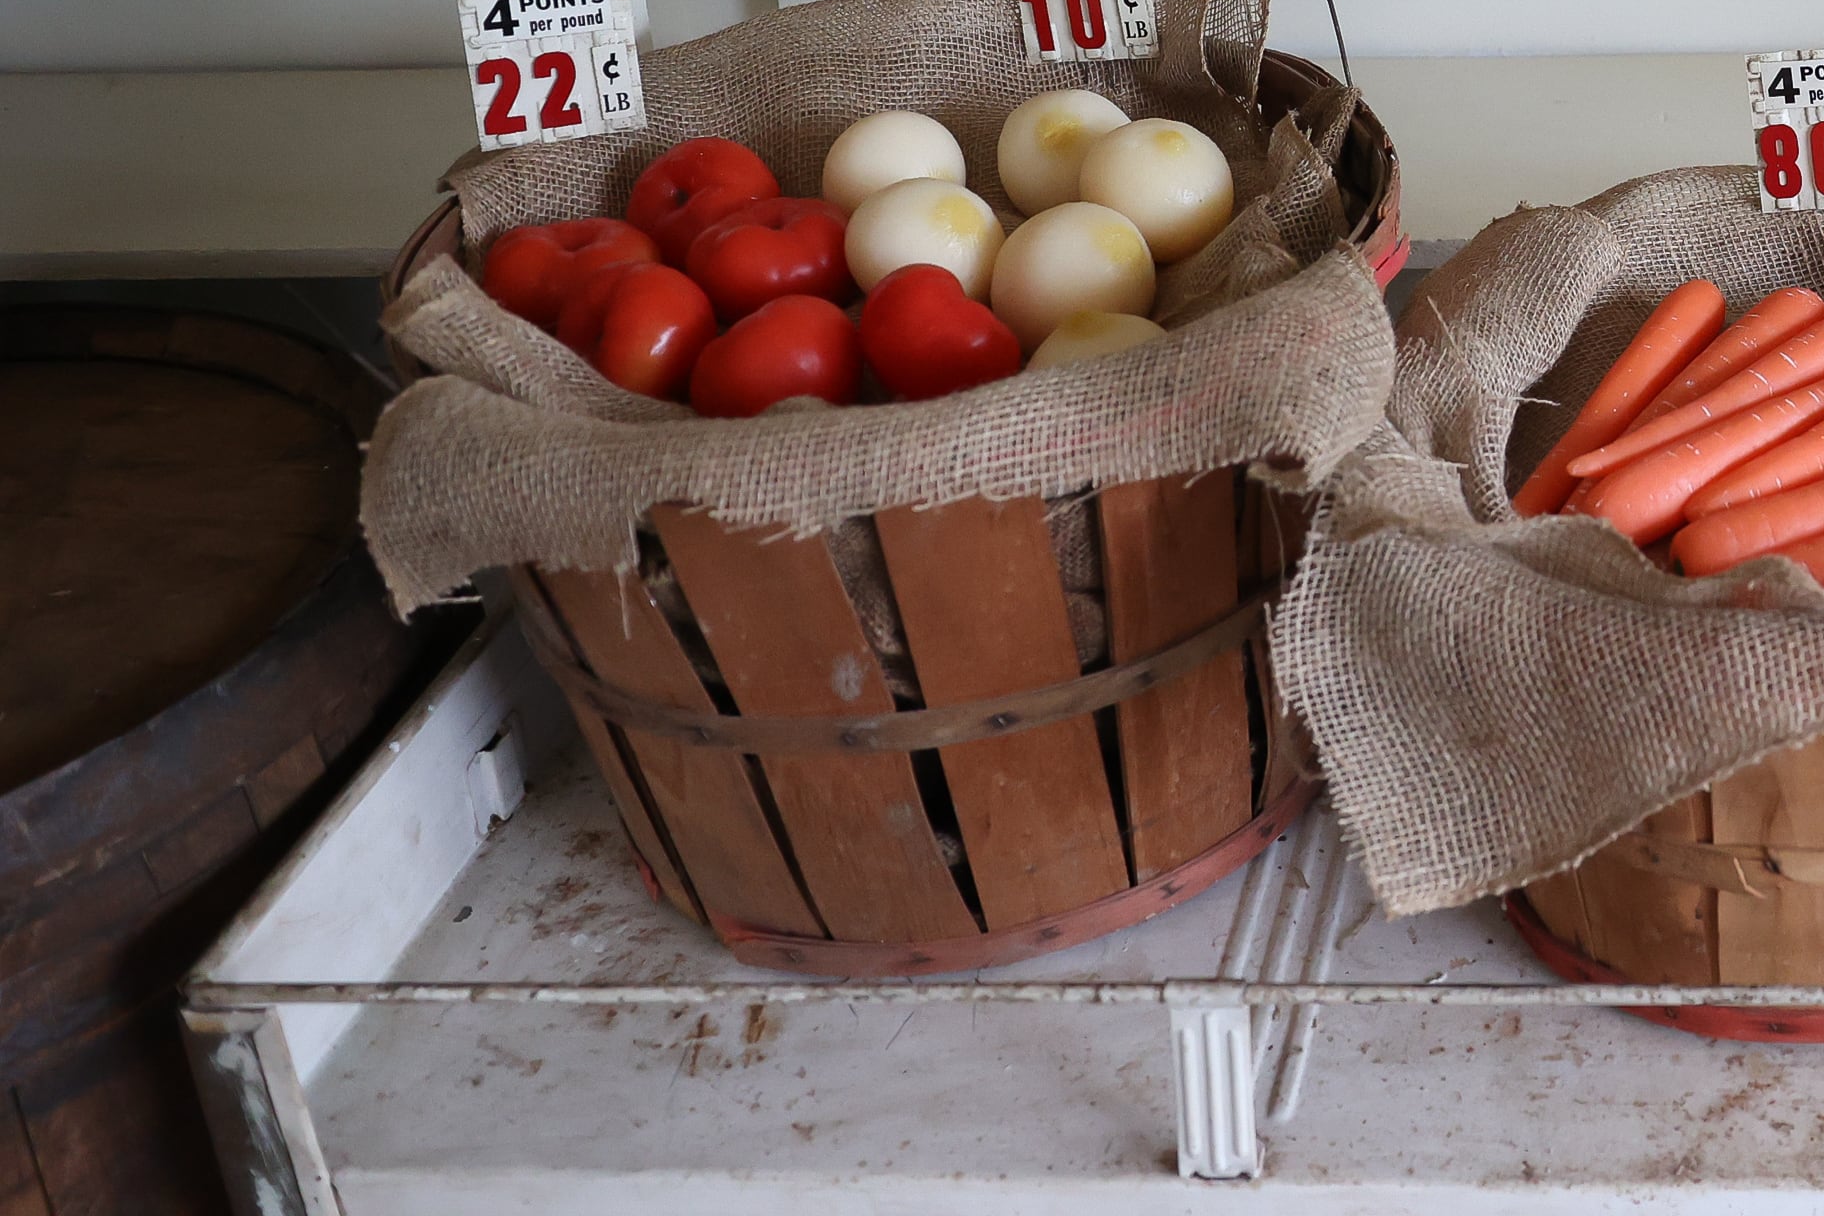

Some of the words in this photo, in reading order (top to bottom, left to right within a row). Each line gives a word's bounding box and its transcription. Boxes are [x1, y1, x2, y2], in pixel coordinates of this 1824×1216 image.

[528, 14, 559, 35] per
[560, 8, 604, 32] pound
[1123, 19, 1150, 40] LB
[477, 51, 584, 136] 22
[602, 52, 621, 82] ¢
[1767, 67, 1801, 105] 4
[602, 91, 632, 115] LB
